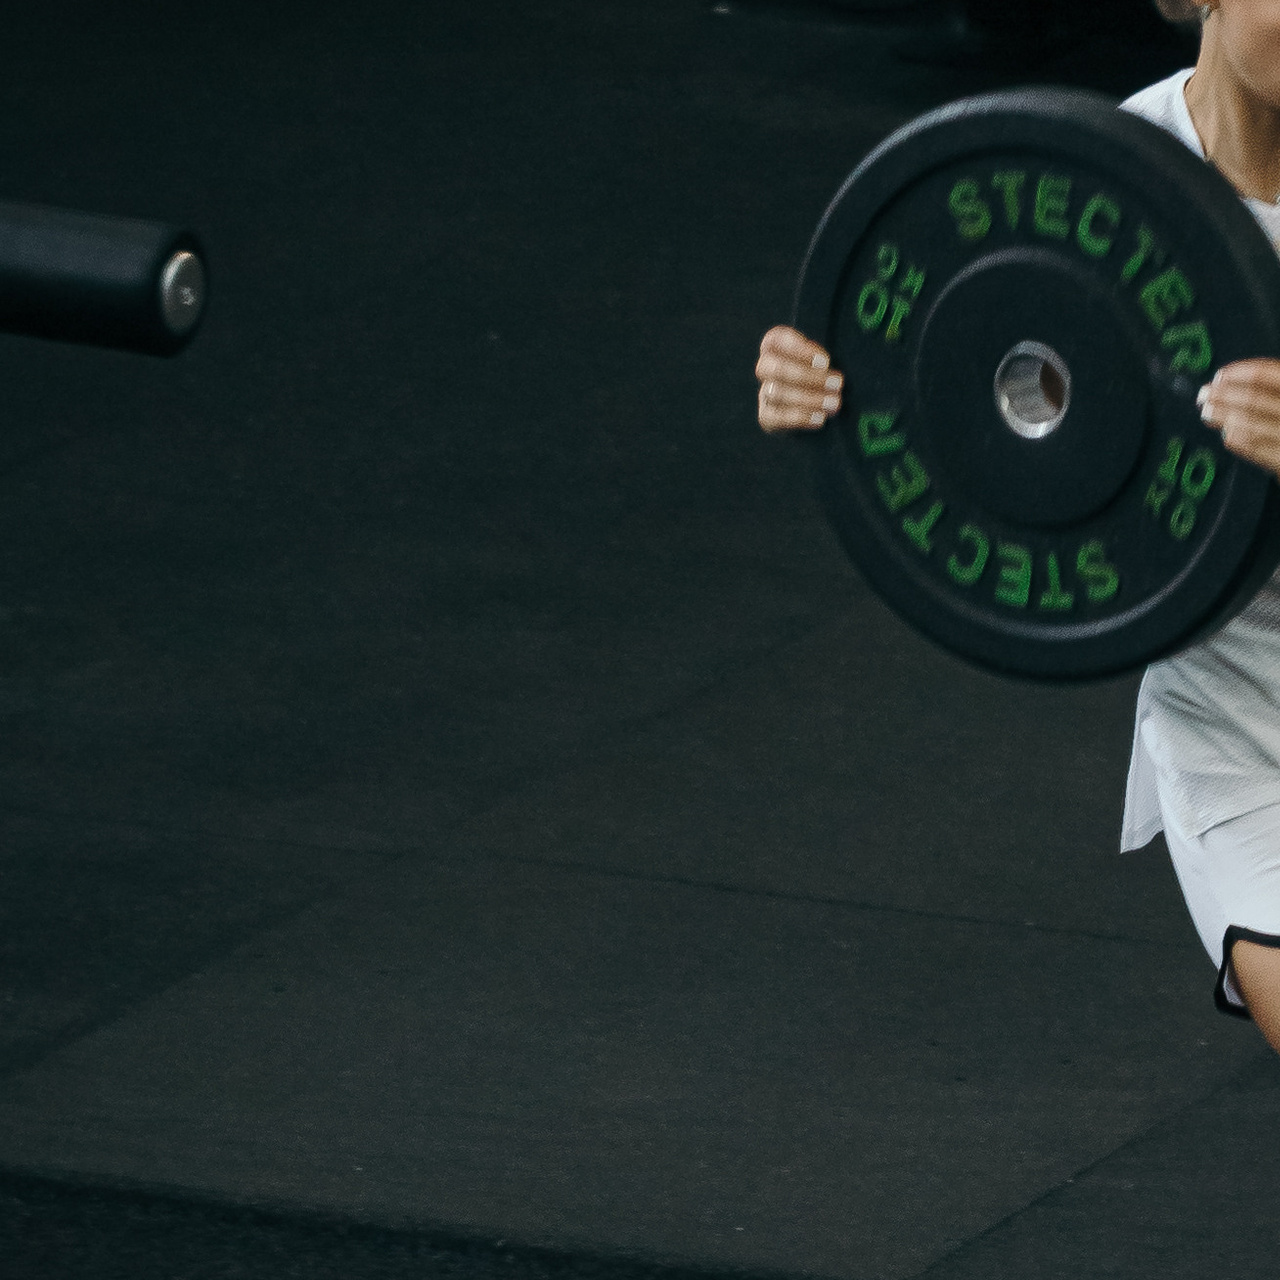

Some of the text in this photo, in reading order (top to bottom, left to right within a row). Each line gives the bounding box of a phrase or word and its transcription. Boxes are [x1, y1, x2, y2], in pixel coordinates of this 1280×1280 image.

[856, 279, 910, 342] 10
[947, 167, 1213, 376] STECTER
[856, 411, 1121, 613] STECTER
[1157, 435, 1217, 501] 10
